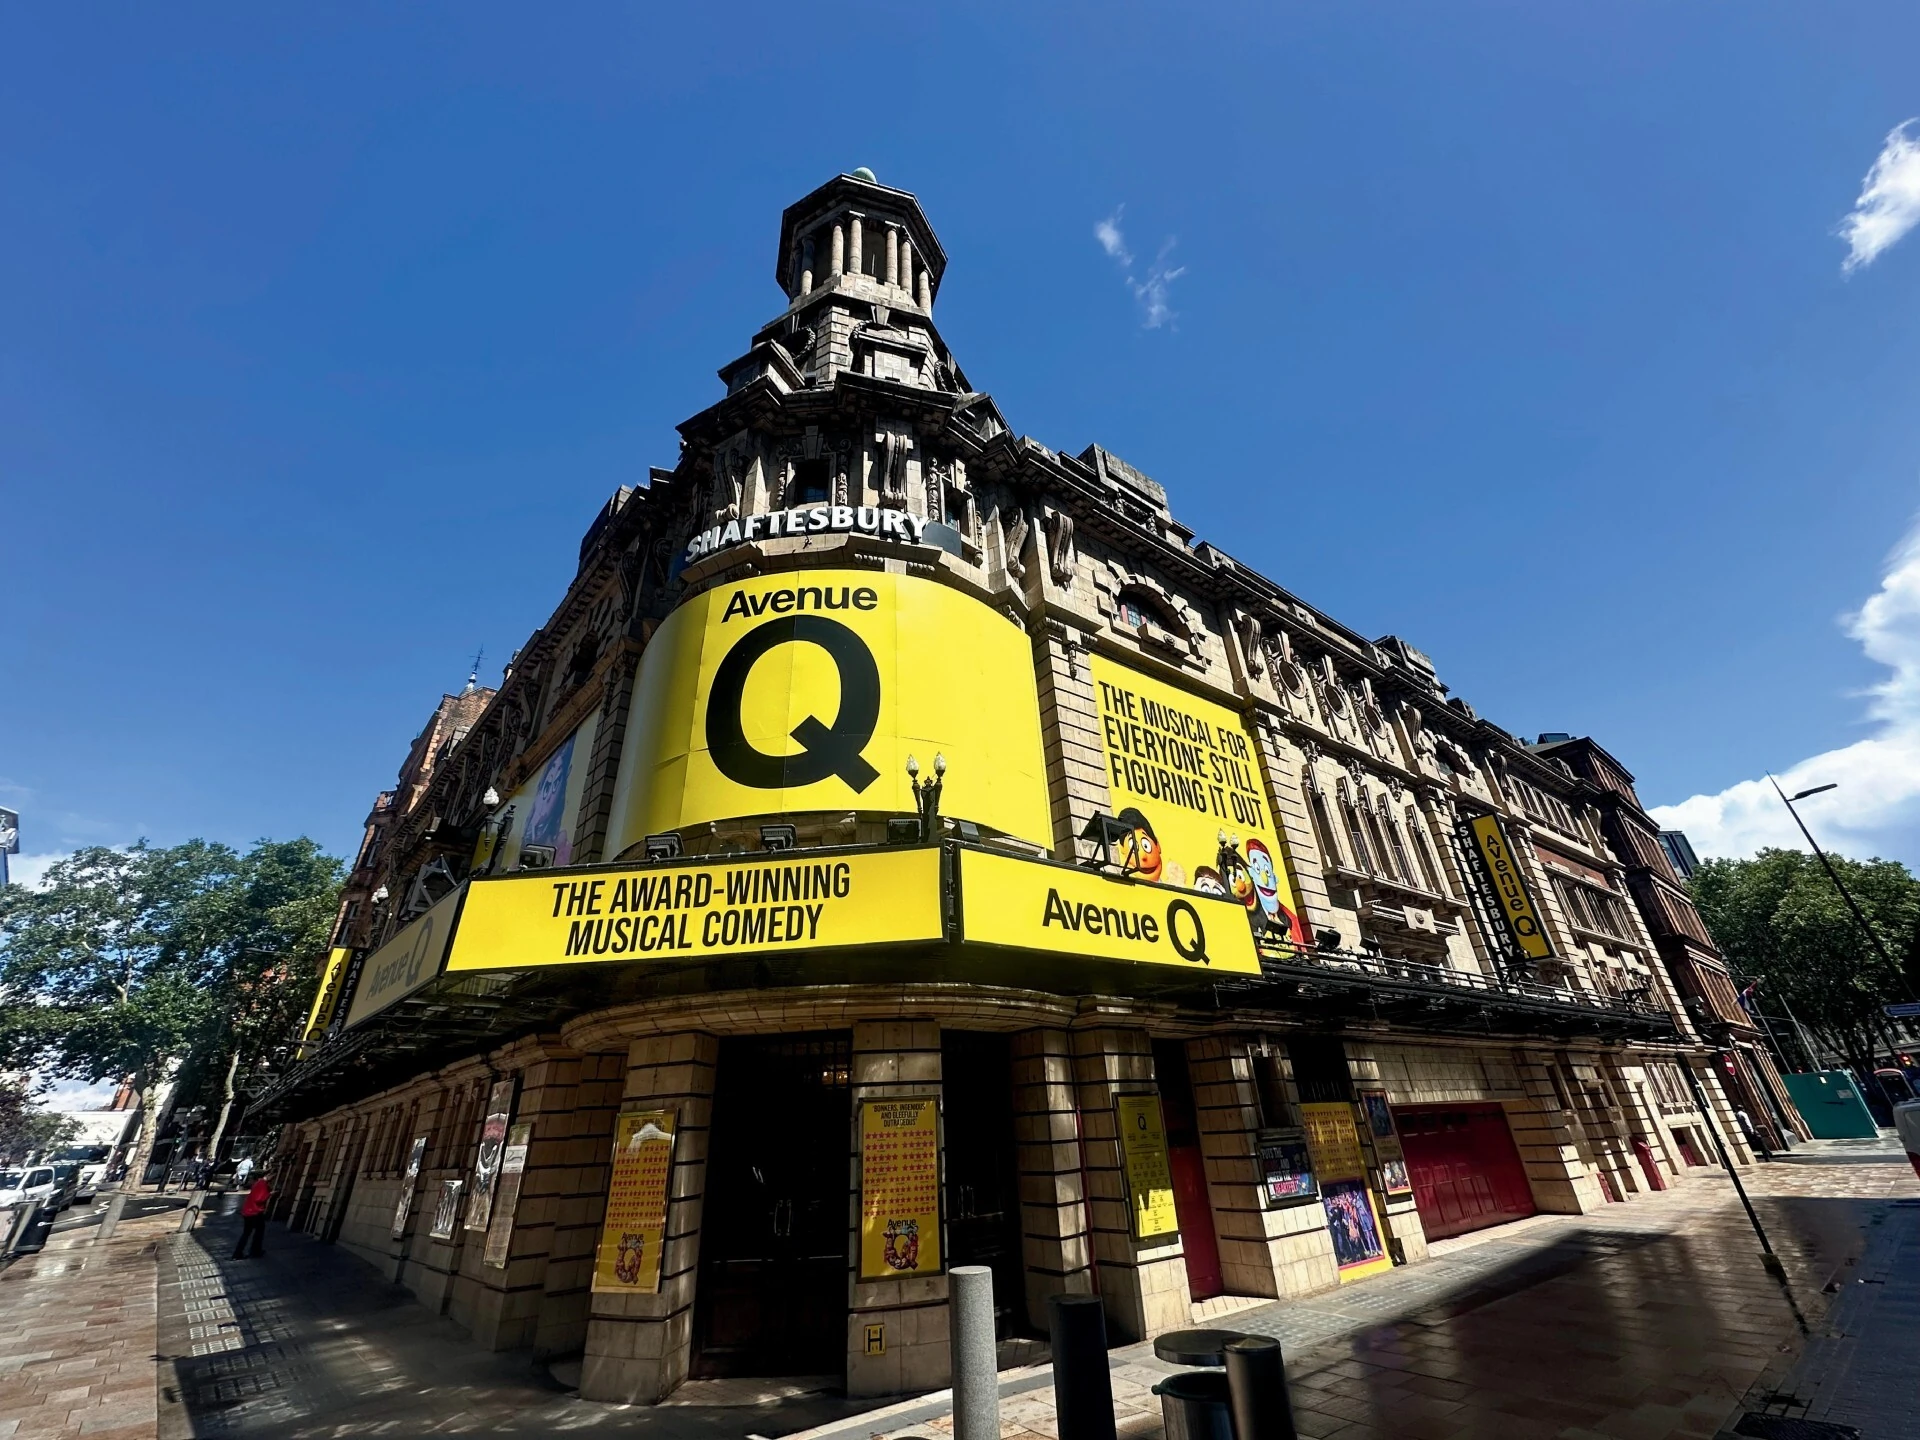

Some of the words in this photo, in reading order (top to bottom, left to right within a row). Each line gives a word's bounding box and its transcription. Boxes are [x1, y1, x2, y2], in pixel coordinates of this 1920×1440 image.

[685, 505, 929, 563] SHAFTESBURY
[721, 586, 878, 623] Avenue
[705, 614, 881, 794] Q
[1098, 680, 1139, 721] THE
[1140, 696, 1222, 750] MUSICAL
[1216, 727, 1250, 762] FOR
[1103, 715, 1209, 779] EVERYONE
[1209, 752, 1259, 796] STILL
[1109, 753, 1207, 813] FIGURING
[1207, 784, 1227, 819] IT
[1230, 790, 1266, 830] OUT
[552, 880, 606, 917] THE
[609, 862, 850, 913] AWARD-WINNING
[1458, 825, 1515, 958] SHAFTESBURY
[1485, 834, 1525, 912] Avenue
[1513, 915, 1539, 938] Q
[565, 914, 693, 956] MUSICAL
[702, 903, 824, 947] COMEDY
[1042, 887, 1160, 943] Avenue
[1166, 898, 1211, 966] Q
[366, 951, 409, 1000] Avenue
[405, 916, 434, 987] Q
[315, 962, 342, 1024] Avenue
[881, 1111, 892, 1119] AND
[1138, 1115, 1147, 1130] Q
[887, 1218, 917, 1228] Avenue
[868, 1327, 882, 1352] H
